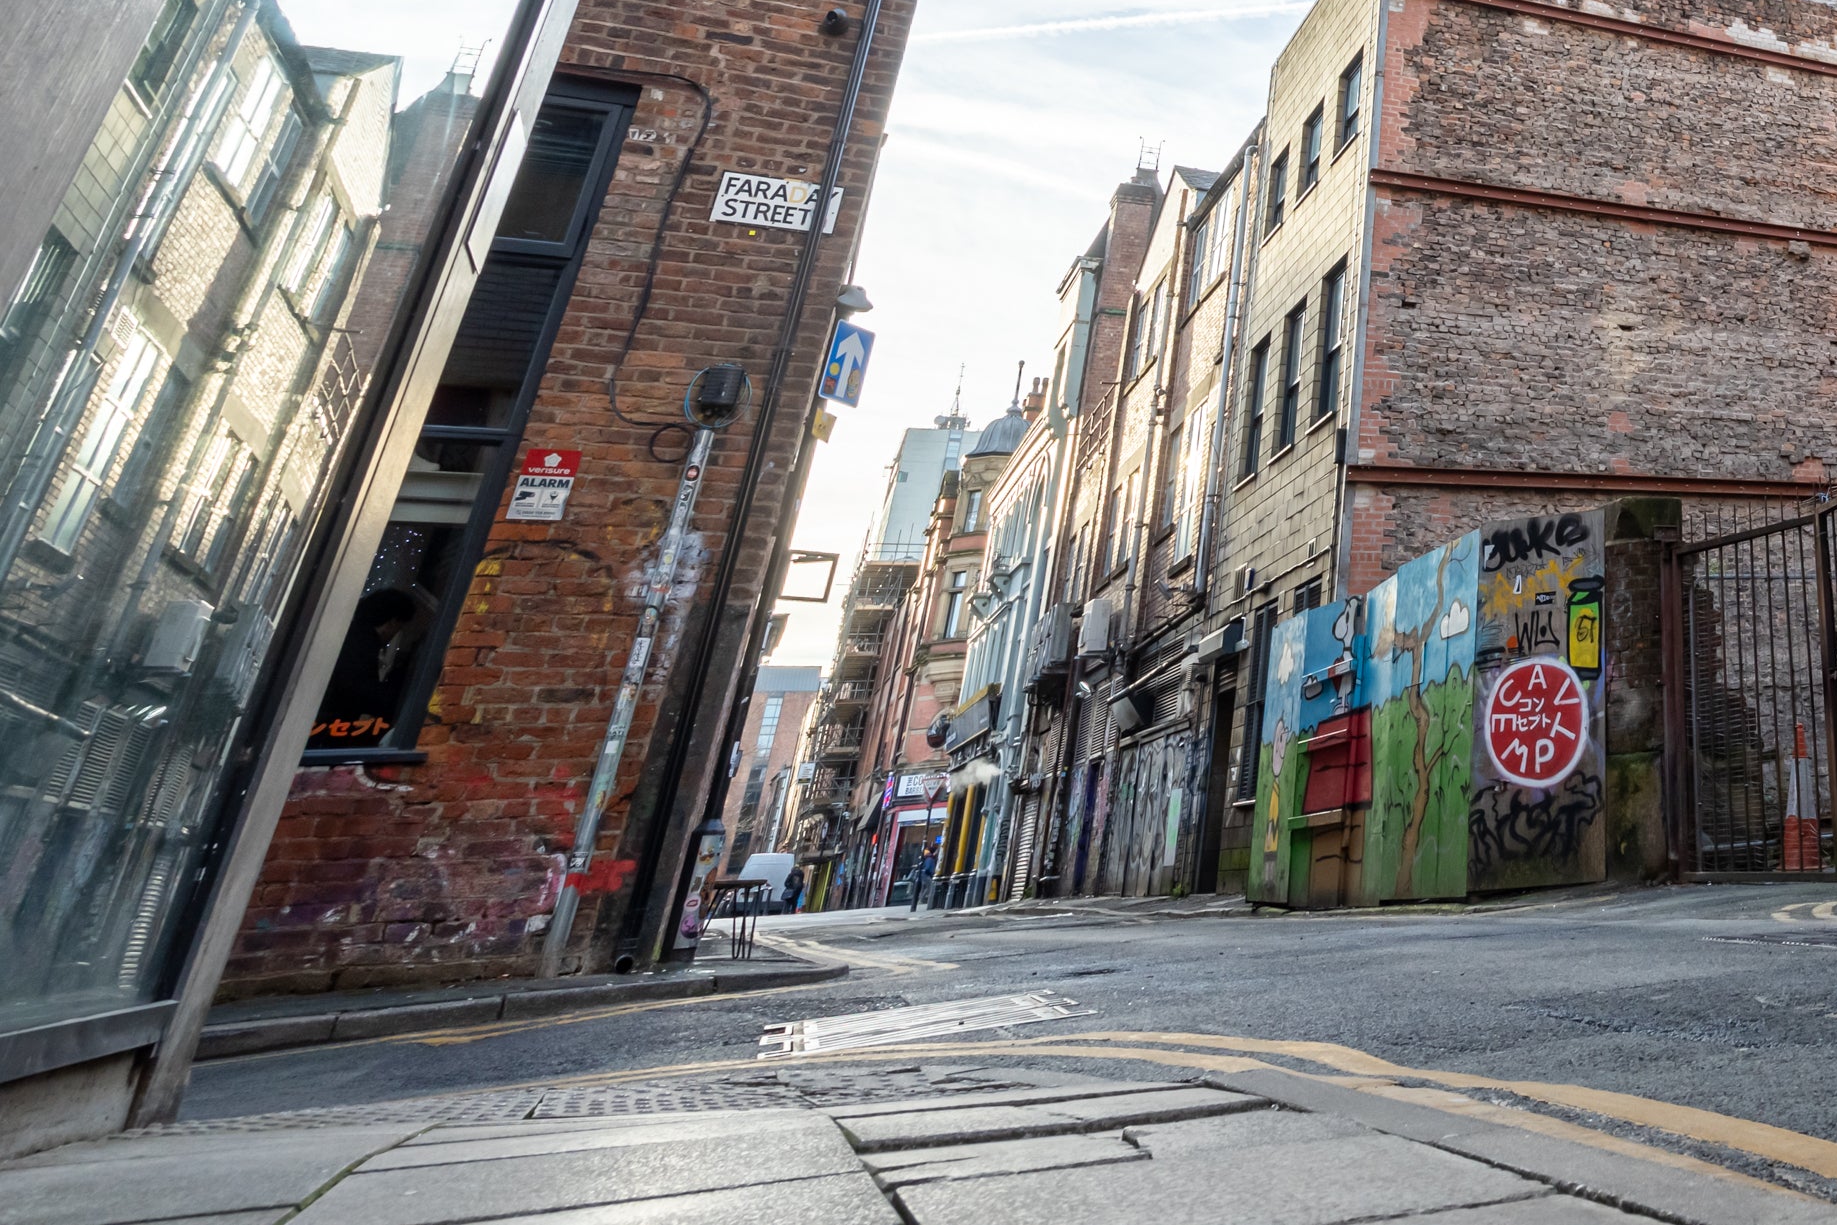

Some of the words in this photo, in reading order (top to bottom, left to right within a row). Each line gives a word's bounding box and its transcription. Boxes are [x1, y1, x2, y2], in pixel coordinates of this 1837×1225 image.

[721, 198, 812, 225] STREET
[528, 467, 570, 475] verisure
[519, 477, 570, 489] ALARM
